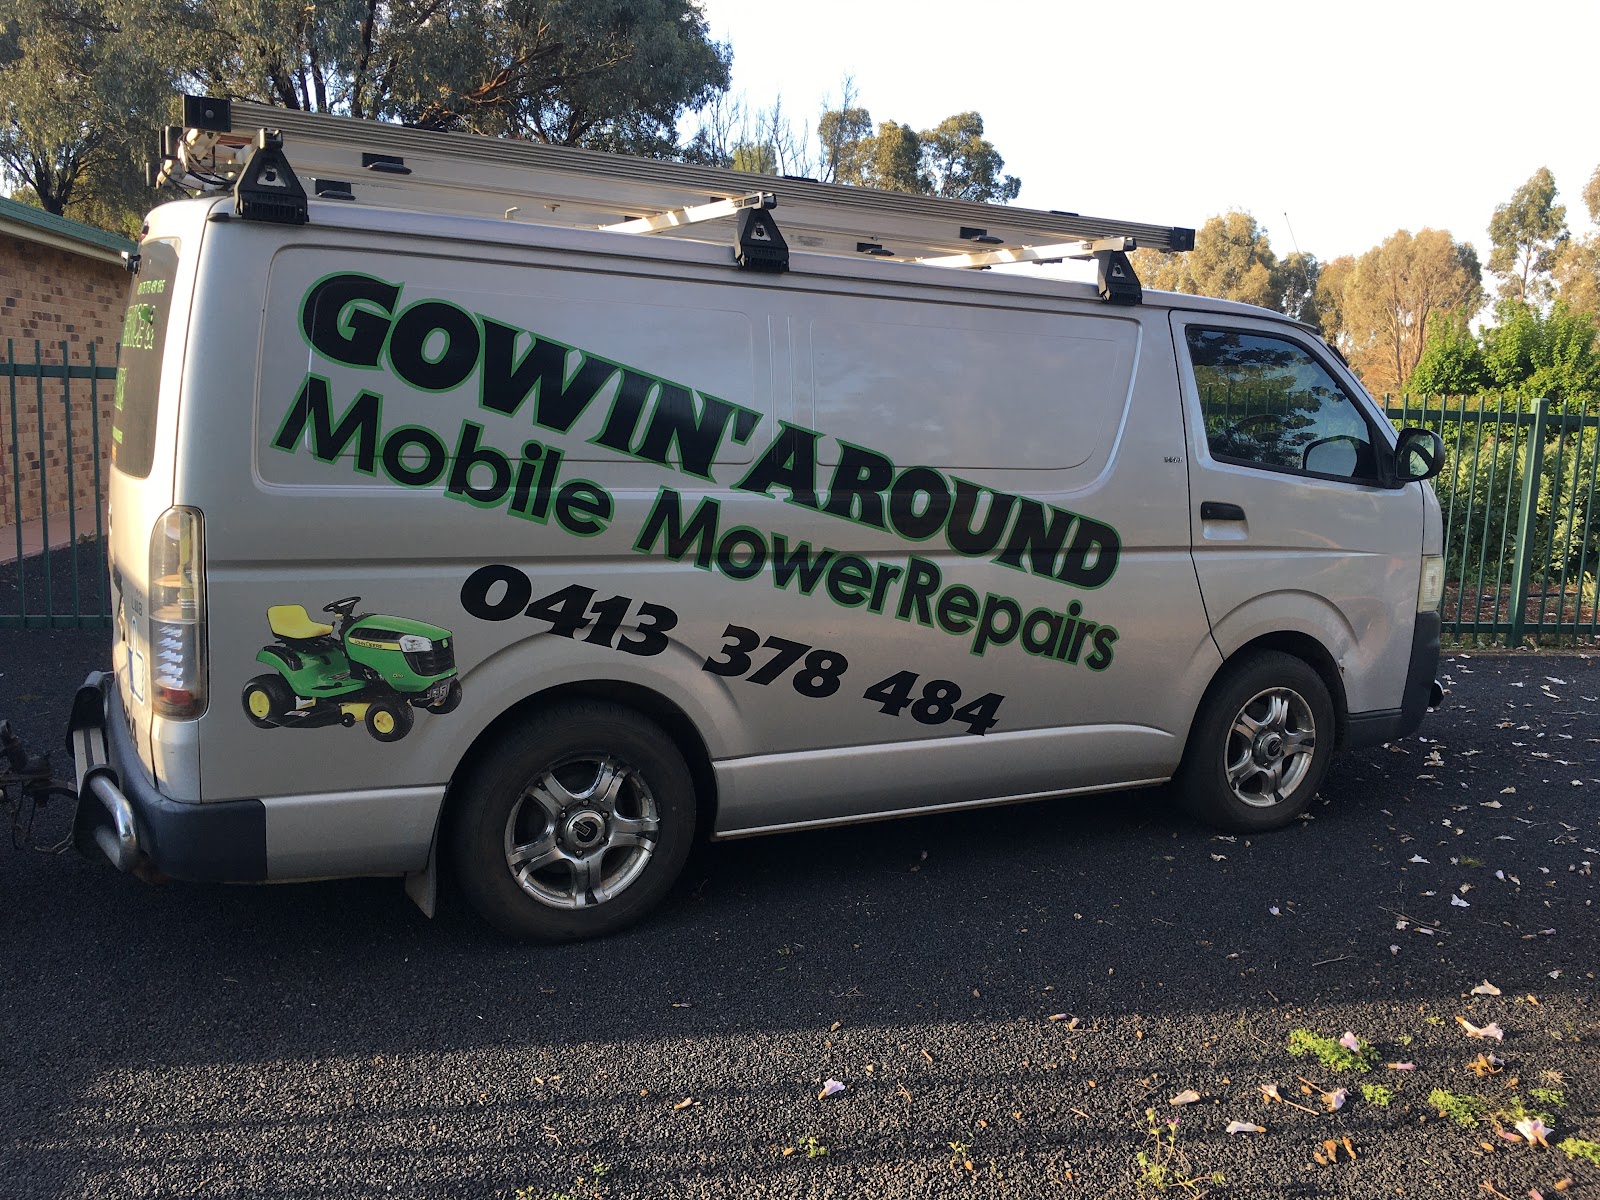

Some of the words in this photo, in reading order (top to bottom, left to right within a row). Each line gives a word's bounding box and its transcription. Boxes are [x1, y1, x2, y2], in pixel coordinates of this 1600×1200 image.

[270, 372, 615, 538] Mobile
[731, 419, 1122, 591] AROUND
[460, 564, 678, 657] 0413
[702, 623, 849, 699] 378
[863, 670, 1006, 737] 484
